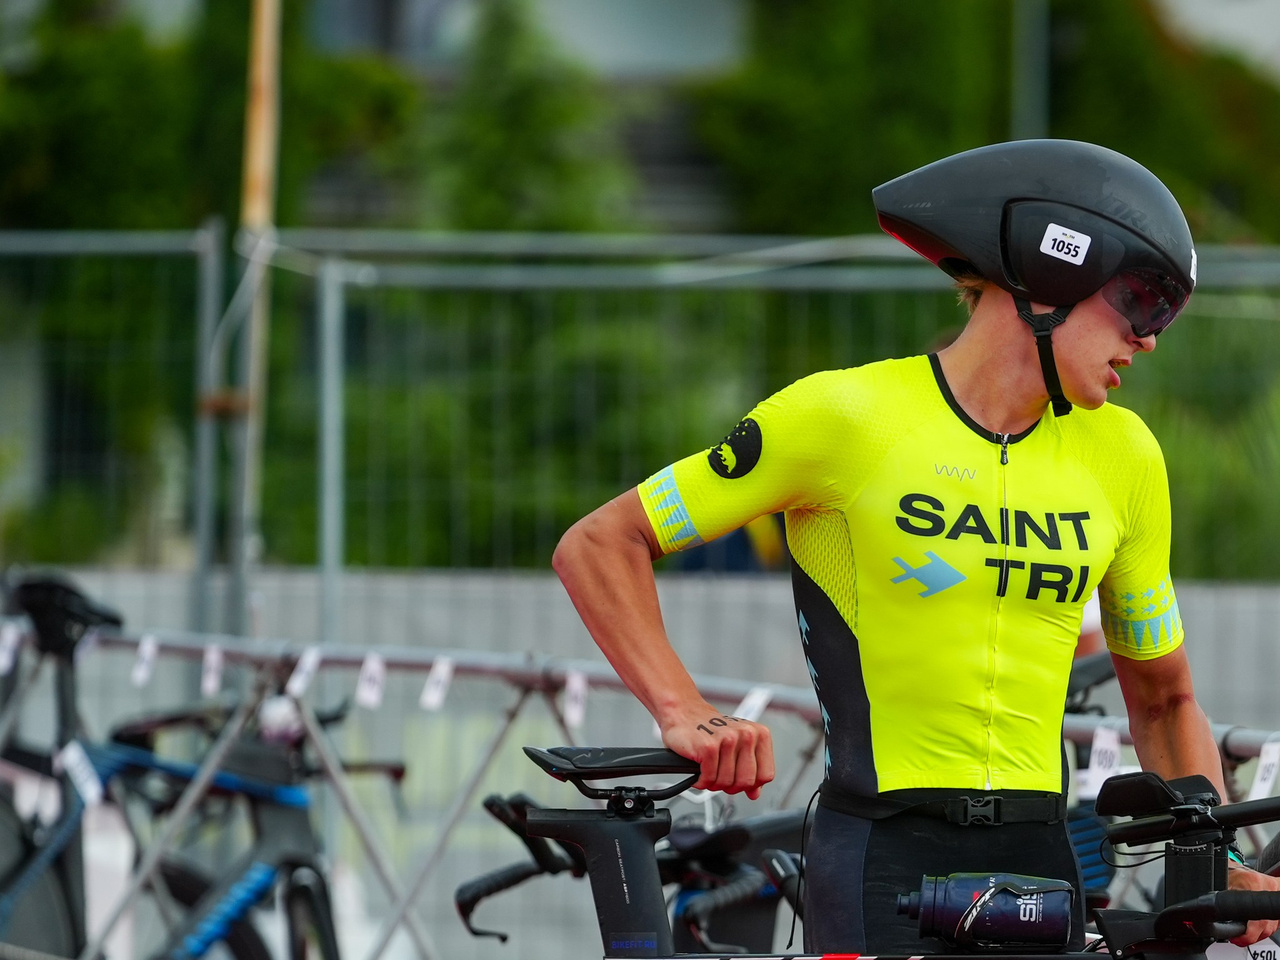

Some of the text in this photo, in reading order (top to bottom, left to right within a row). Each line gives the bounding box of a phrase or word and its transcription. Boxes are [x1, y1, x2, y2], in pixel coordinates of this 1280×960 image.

[1050, 237, 1081, 258] 1055
[895, 493, 1091, 550] SAINT
[984, 557, 1090, 603] TRI
[696, 715, 747, 736] 10
